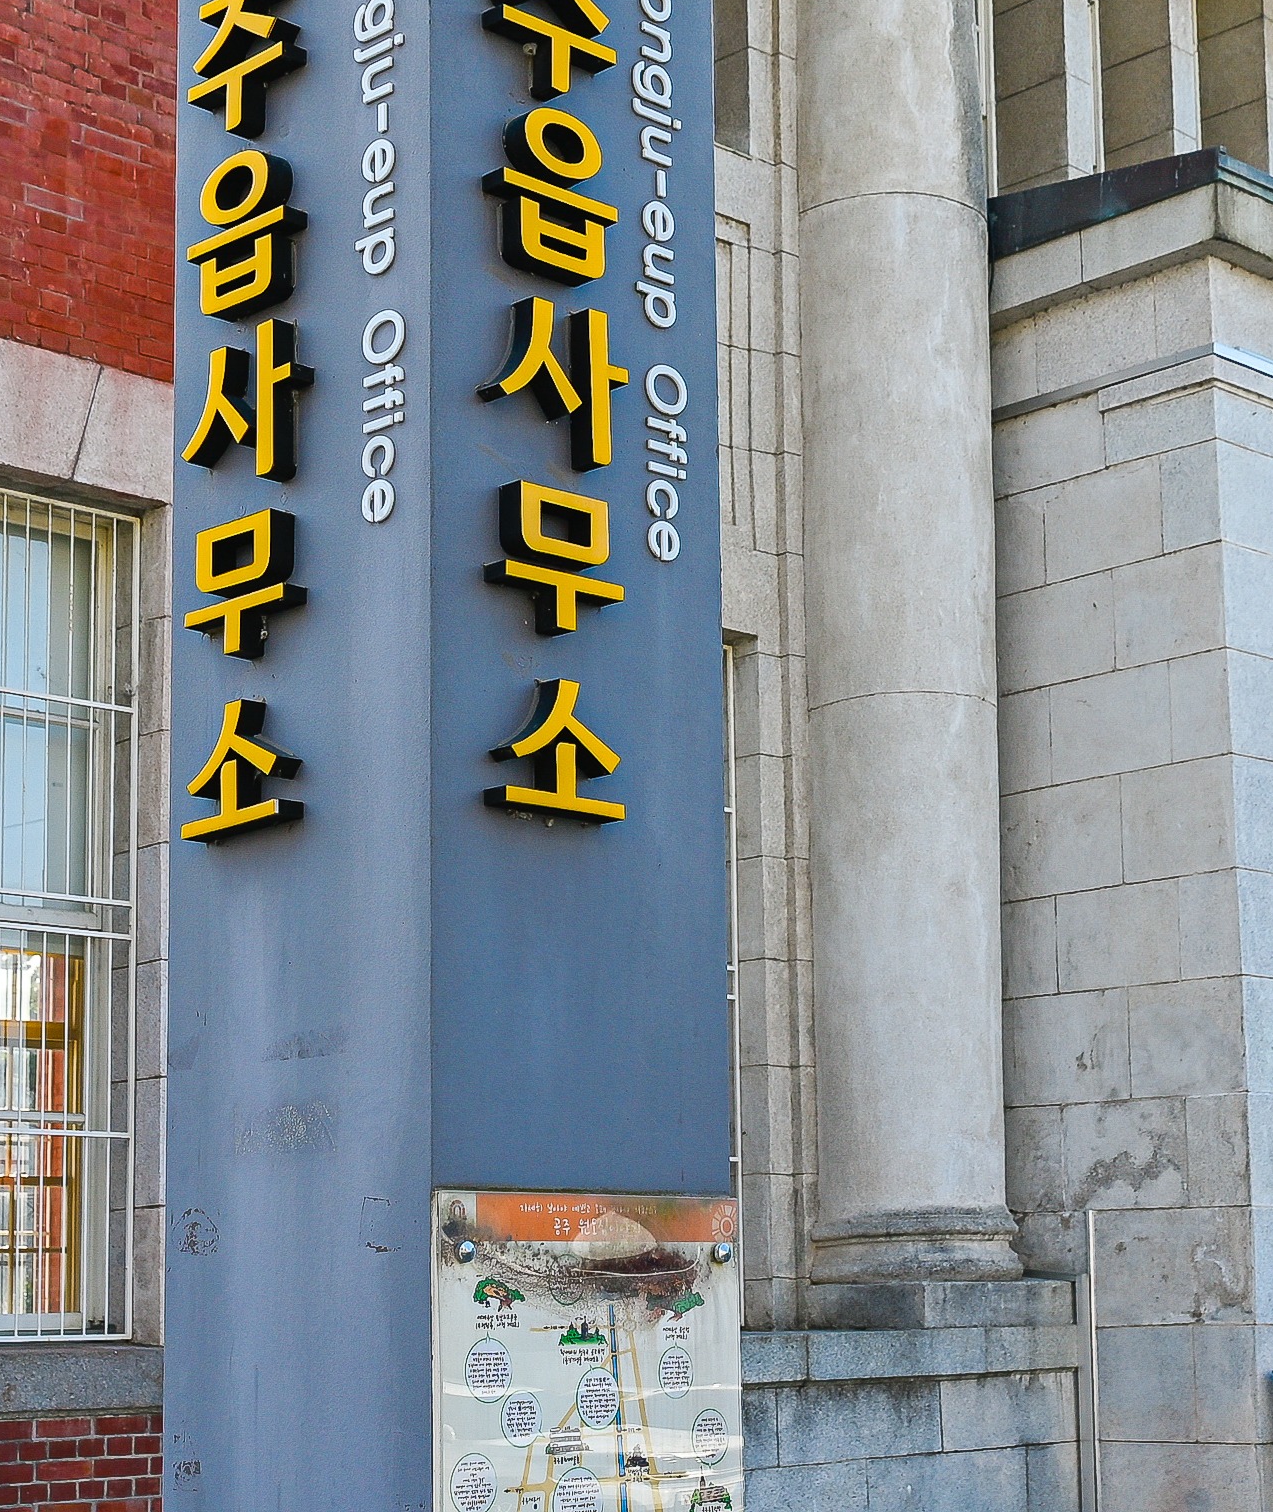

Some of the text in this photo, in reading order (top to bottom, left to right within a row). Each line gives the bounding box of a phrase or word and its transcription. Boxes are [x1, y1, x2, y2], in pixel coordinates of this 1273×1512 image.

[360, 309, 406, 524] Office
[644, 364, 688, 562] Office
[553, 1217, 571, 1236] 공주
